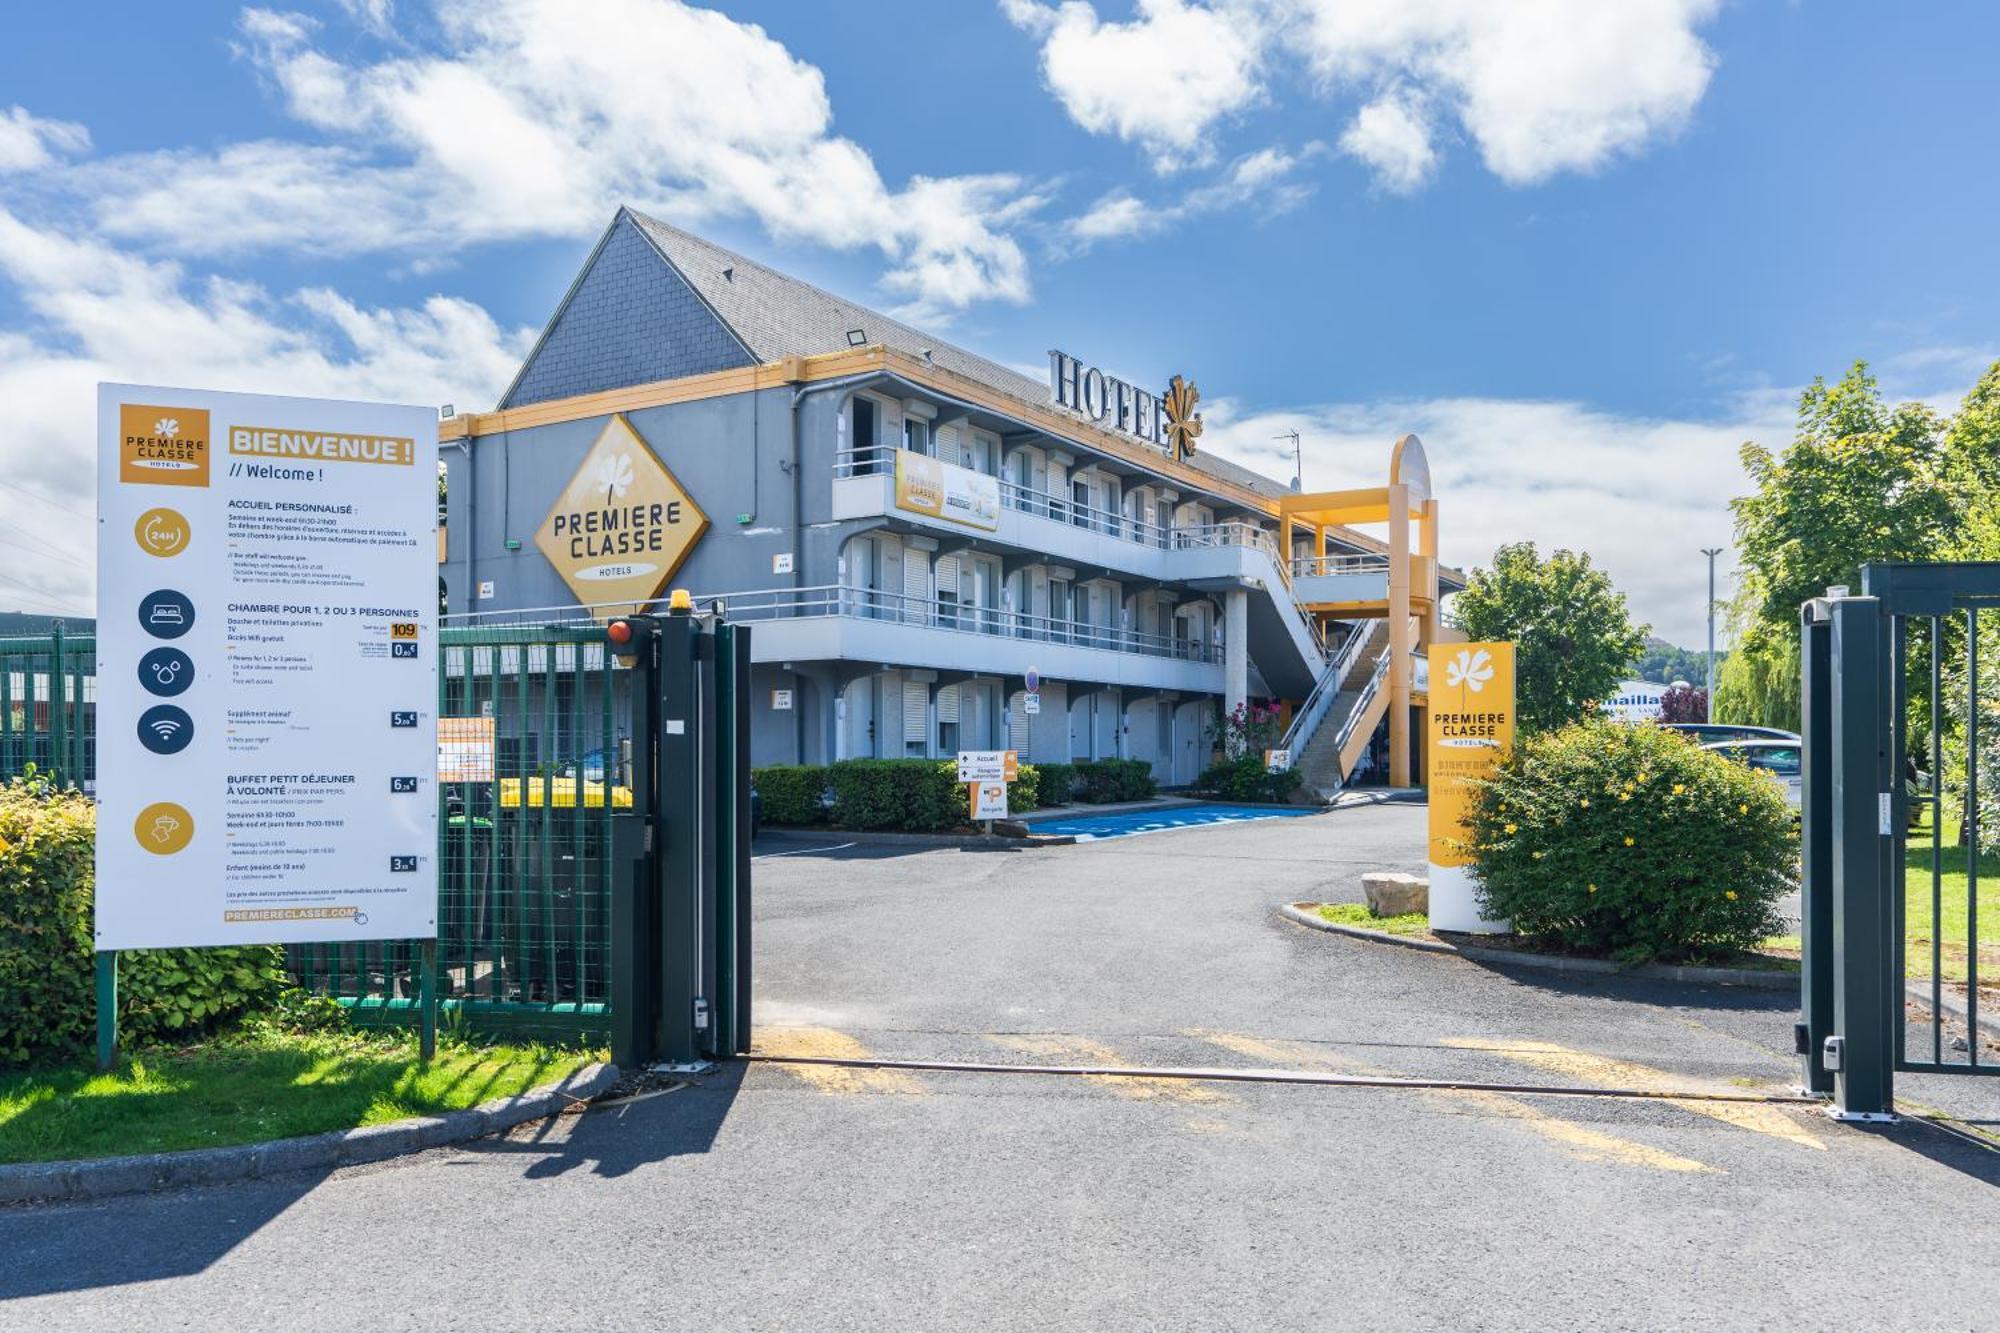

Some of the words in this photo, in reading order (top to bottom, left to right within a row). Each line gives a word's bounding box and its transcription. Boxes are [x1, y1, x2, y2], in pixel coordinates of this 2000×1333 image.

[1048, 350, 1170, 449] HOTEL
[126, 436, 204, 450] PREMIERE
[233, 430, 398, 461] BIENVENUE
[404, 443, 411, 462] !
[138, 447, 194, 460] CLASSE
[247, 464, 314, 481] Welcome
[228, 500, 272, 510] ACCUEIL
[275, 502, 352, 514] PERSONNALISÉ
[554, 501, 681, 537] PREMIERE
[151, 531, 175, 541] 24H
[571, 528, 662, 559] CLASSE
[599, 566, 632, 577] HOTELS
[228, 603, 280, 613] CHAMBRE
[283, 605, 312, 614] POUR
[324, 607, 330, 615] 2
[333, 607, 348, 615] OU
[350, 608, 357, 616] 3
[359, 608, 419, 618] PERSONNES
[392, 623, 415, 636] 109
[1434, 713, 1505, 724] PREMIERE
[1443, 725, 1496, 737] CLASSE
[227, 775, 267, 784] BUFFET
[270, 775, 298, 784] PETIT
[301, 773, 355, 783] DÉJEUNER
[227, 785, 235, 795] À
[237, 785, 286, 795] VOLONTÉ
[226, 908, 356, 920] PREMIERECLASSE.COM
